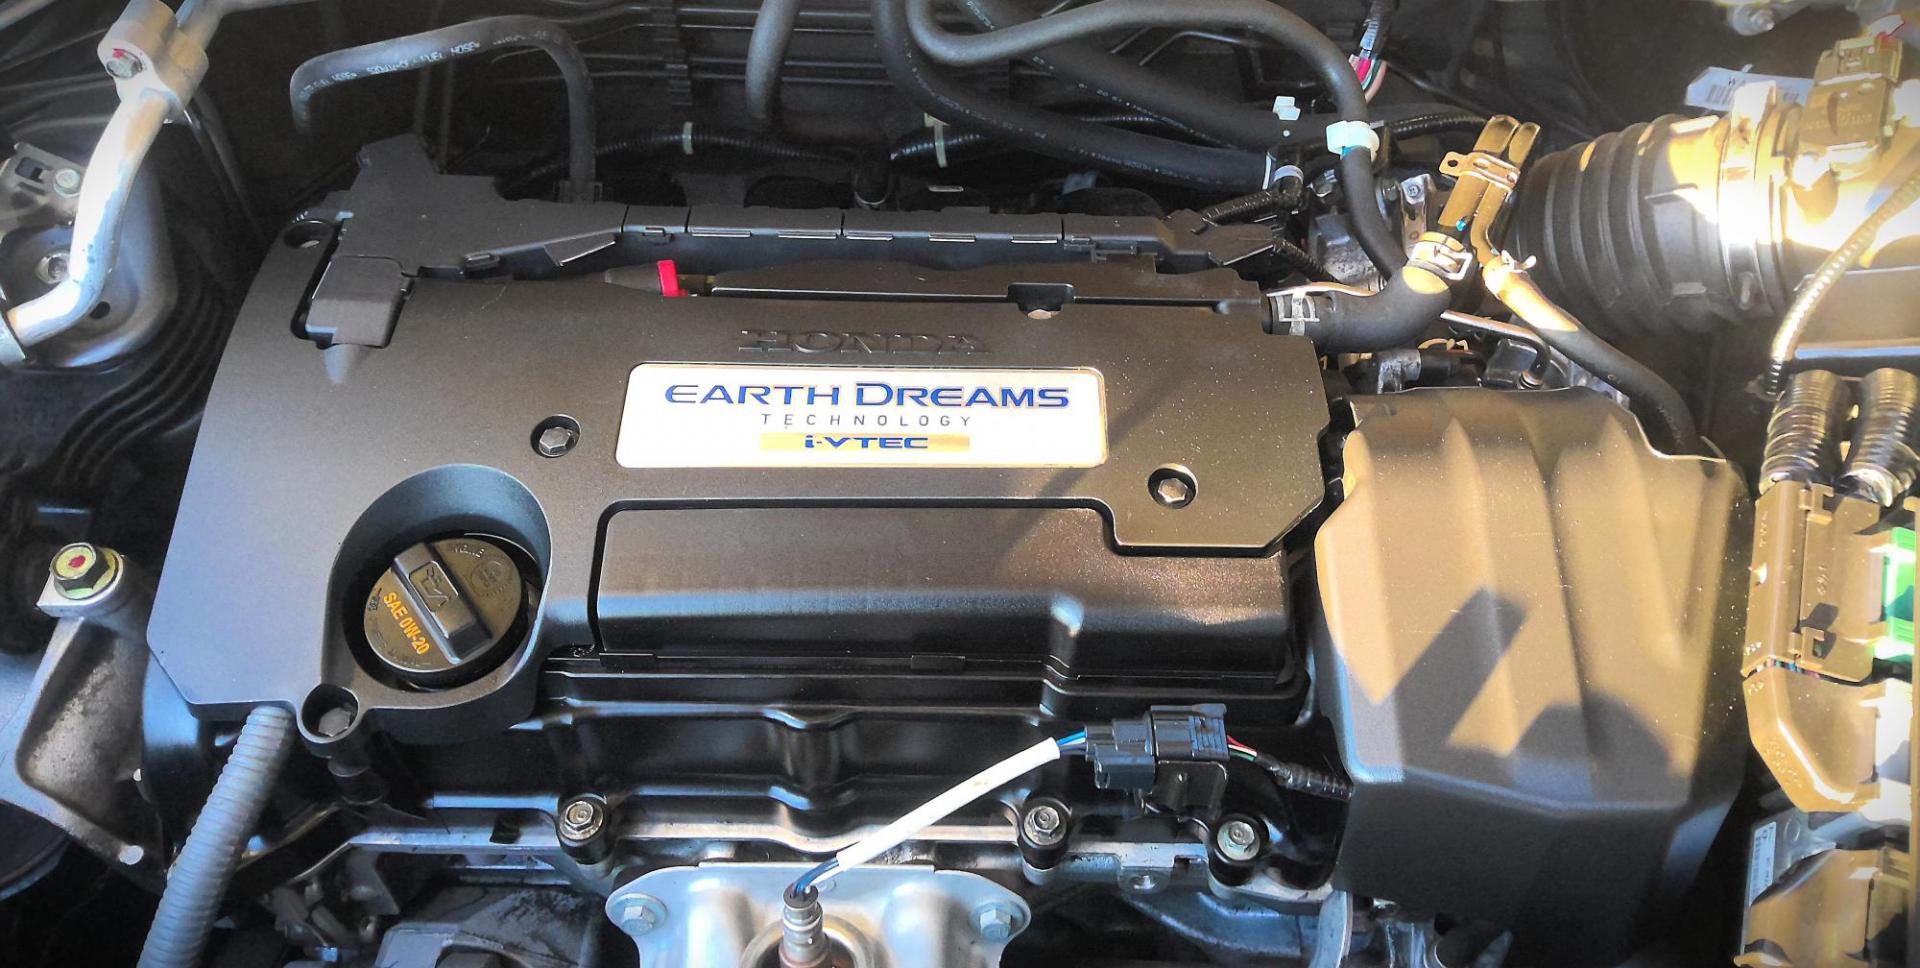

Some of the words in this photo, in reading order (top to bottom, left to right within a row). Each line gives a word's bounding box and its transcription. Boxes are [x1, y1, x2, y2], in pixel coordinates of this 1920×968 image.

[738, 330, 989, 354] HONDA
[665, 384, 840, 406] EARTH
[856, 382, 1069, 407] DREAMS
[761, 413, 972, 428] TECHNOLOGY
[805, 434, 928, 450] i-VTEC
[384, 592, 408, 620] SAE
[400, 619, 430, 655] 0W-20
